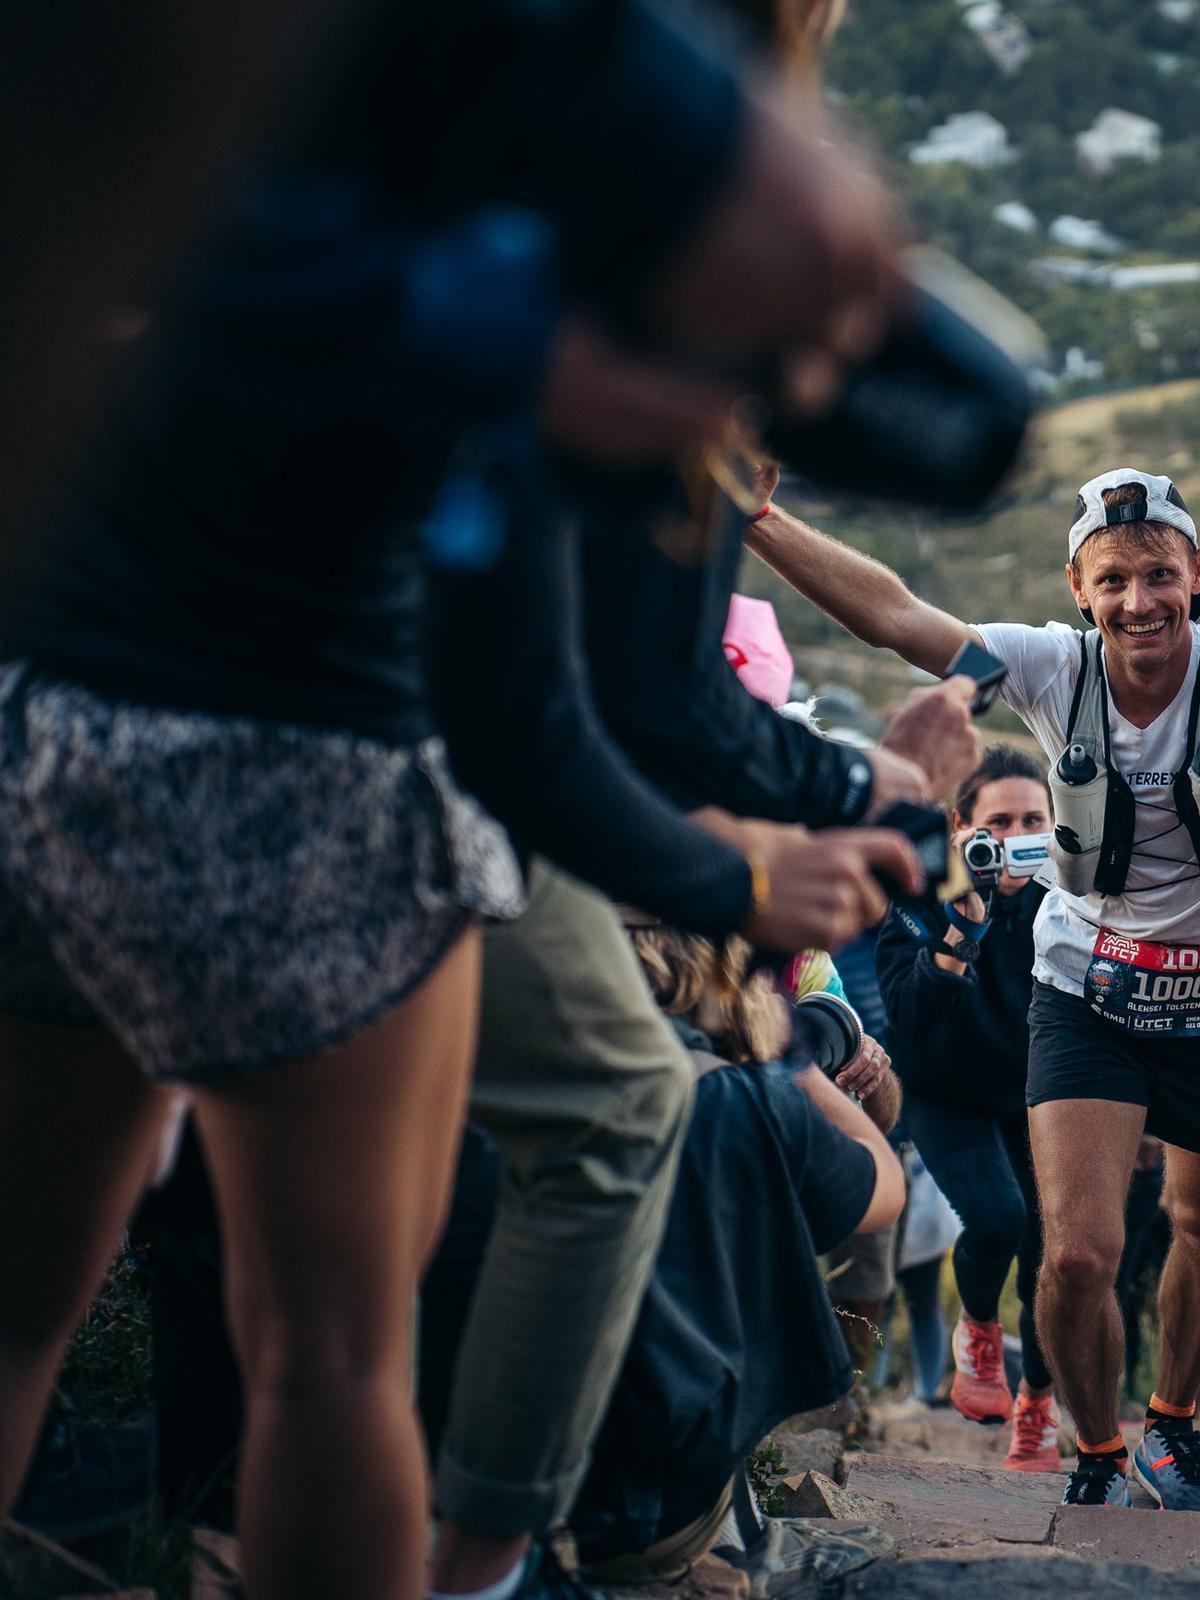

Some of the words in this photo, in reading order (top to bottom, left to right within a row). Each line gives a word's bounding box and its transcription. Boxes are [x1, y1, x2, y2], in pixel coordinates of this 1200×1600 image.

[1100, 943, 1139, 961] UTCT
[1103, 1011, 1126, 1025] RMB
[1134, 1018, 1173, 1028] UTCT
